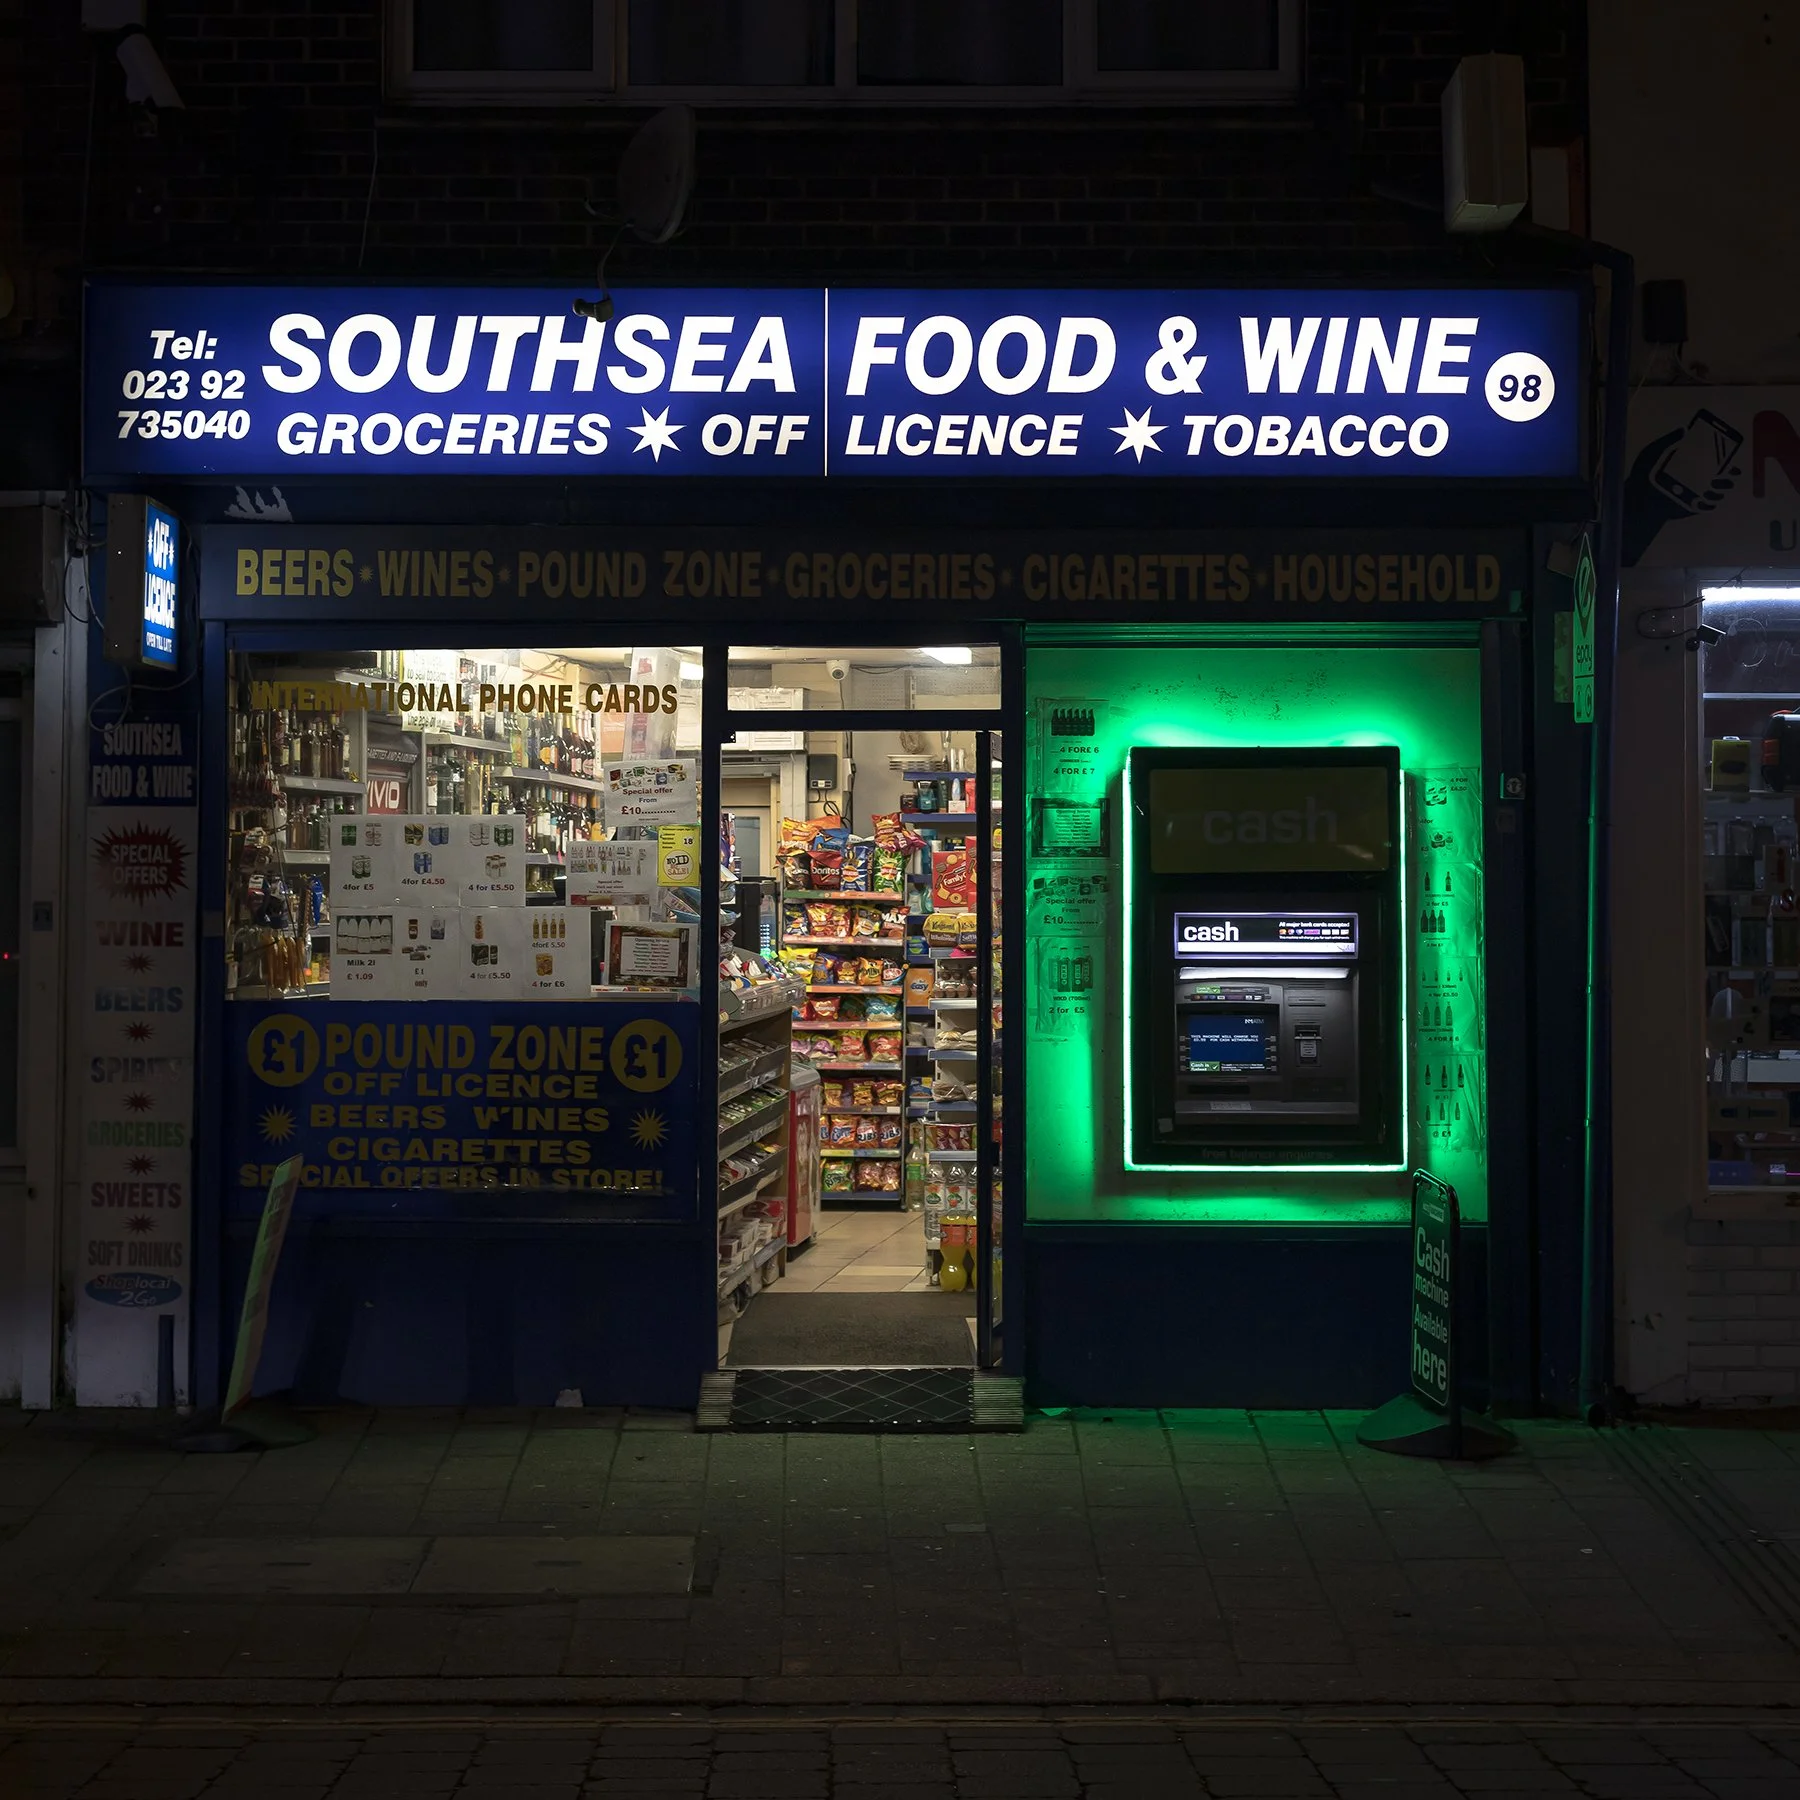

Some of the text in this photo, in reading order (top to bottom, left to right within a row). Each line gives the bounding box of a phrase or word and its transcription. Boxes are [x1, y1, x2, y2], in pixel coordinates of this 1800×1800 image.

[150, 330, 218, 360] Tel:
[261, 313, 1479, 396] SOUTHSEA FOOD & WINE
[122, 370, 246, 400] 023 92
[1498, 375, 1541, 402] 98
[117, 410, 250, 440] 735040
[276, 412, 1449, 457] GROCERIES OFF LICENCE TOBACCO
[153, 518, 170, 570] OFF
[236, 548, 1500, 602] BEERS WINES POUND ZONE GROCERIES CIGARETTES HOUSEHOLD
[144, 572, 176, 629] LICENCE
[251, 681, 677, 714] INTERNATIONAL PHONE CARDS
[103, 722, 182, 755] SOUTHSEA
[92, 765, 193, 799] FOOD & WINE
[622, 788, 652, 796] Special
[1203, 797, 1338, 845] cash
[111, 844, 172, 865] SPECIAL
[113, 866, 169, 886] OFFERS
[812, 867, 840, 875] Doritos
[96, 921, 184, 947] WINE
[1183, 922, 1239, 941] cash
[95, 987, 184, 1013] BEERS
[262, 1023, 667, 1080] £1 POUND ZONE £1
[324, 1072, 598, 1099] OFF LICENCE
[310, 1104, 446, 1130] BEERS
[88, 1121, 184, 1148] GROCERIES
[328, 1137, 591, 1164] CIGARETTES
[239, 1163, 663, 1191] SPCIAL OFFERS IN STORE!
[91, 1182, 182, 1209] SWEETS
[88, 1240, 182, 1268] SOFT DRINKS
[1416, 1226, 1450, 1282] Cash
[1415, 1272, 1449, 1309] machine
[1414, 1303, 1448, 1344] Available
[1413, 1328, 1447, 1392] here
